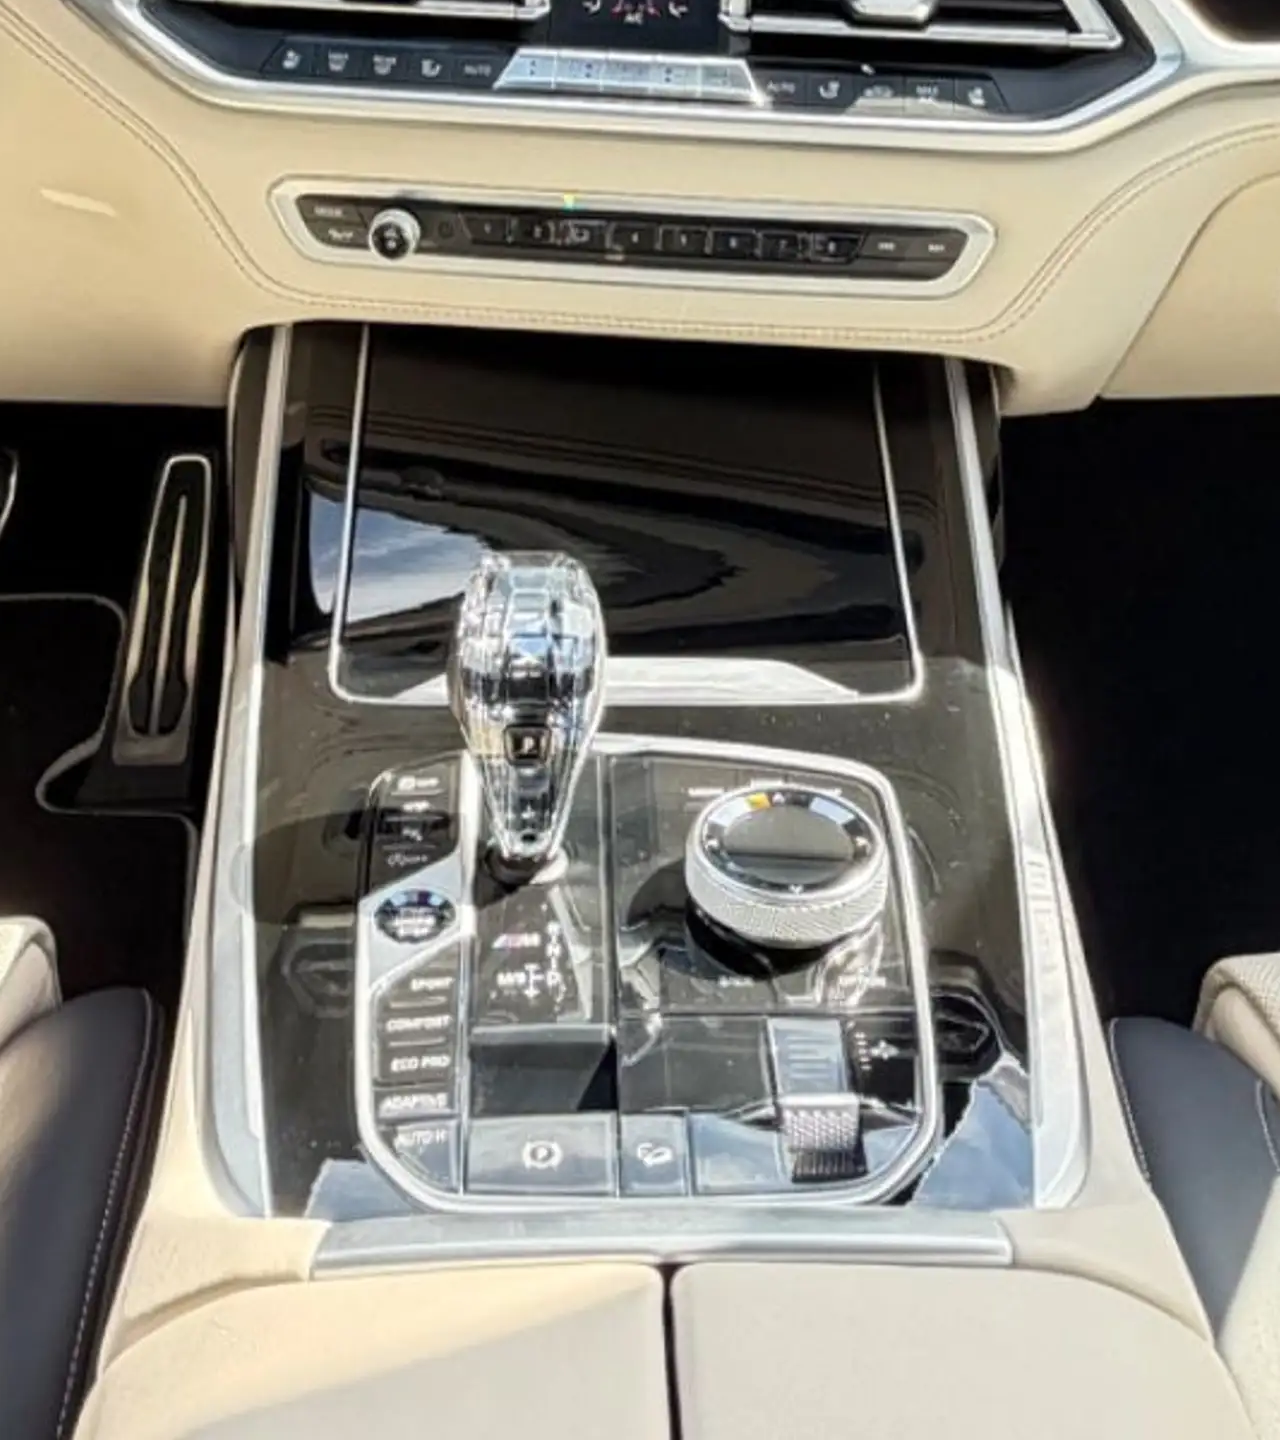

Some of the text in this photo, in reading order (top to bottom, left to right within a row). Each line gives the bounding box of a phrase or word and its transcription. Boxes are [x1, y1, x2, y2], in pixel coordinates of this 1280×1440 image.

[410, 976, 455, 992] SPORT
[386, 1014, 452, 1032] COMFORT
[390, 1053, 452, 1072] ECO PRO
[378, 1092, 449, 1110] ADAPTIVE
